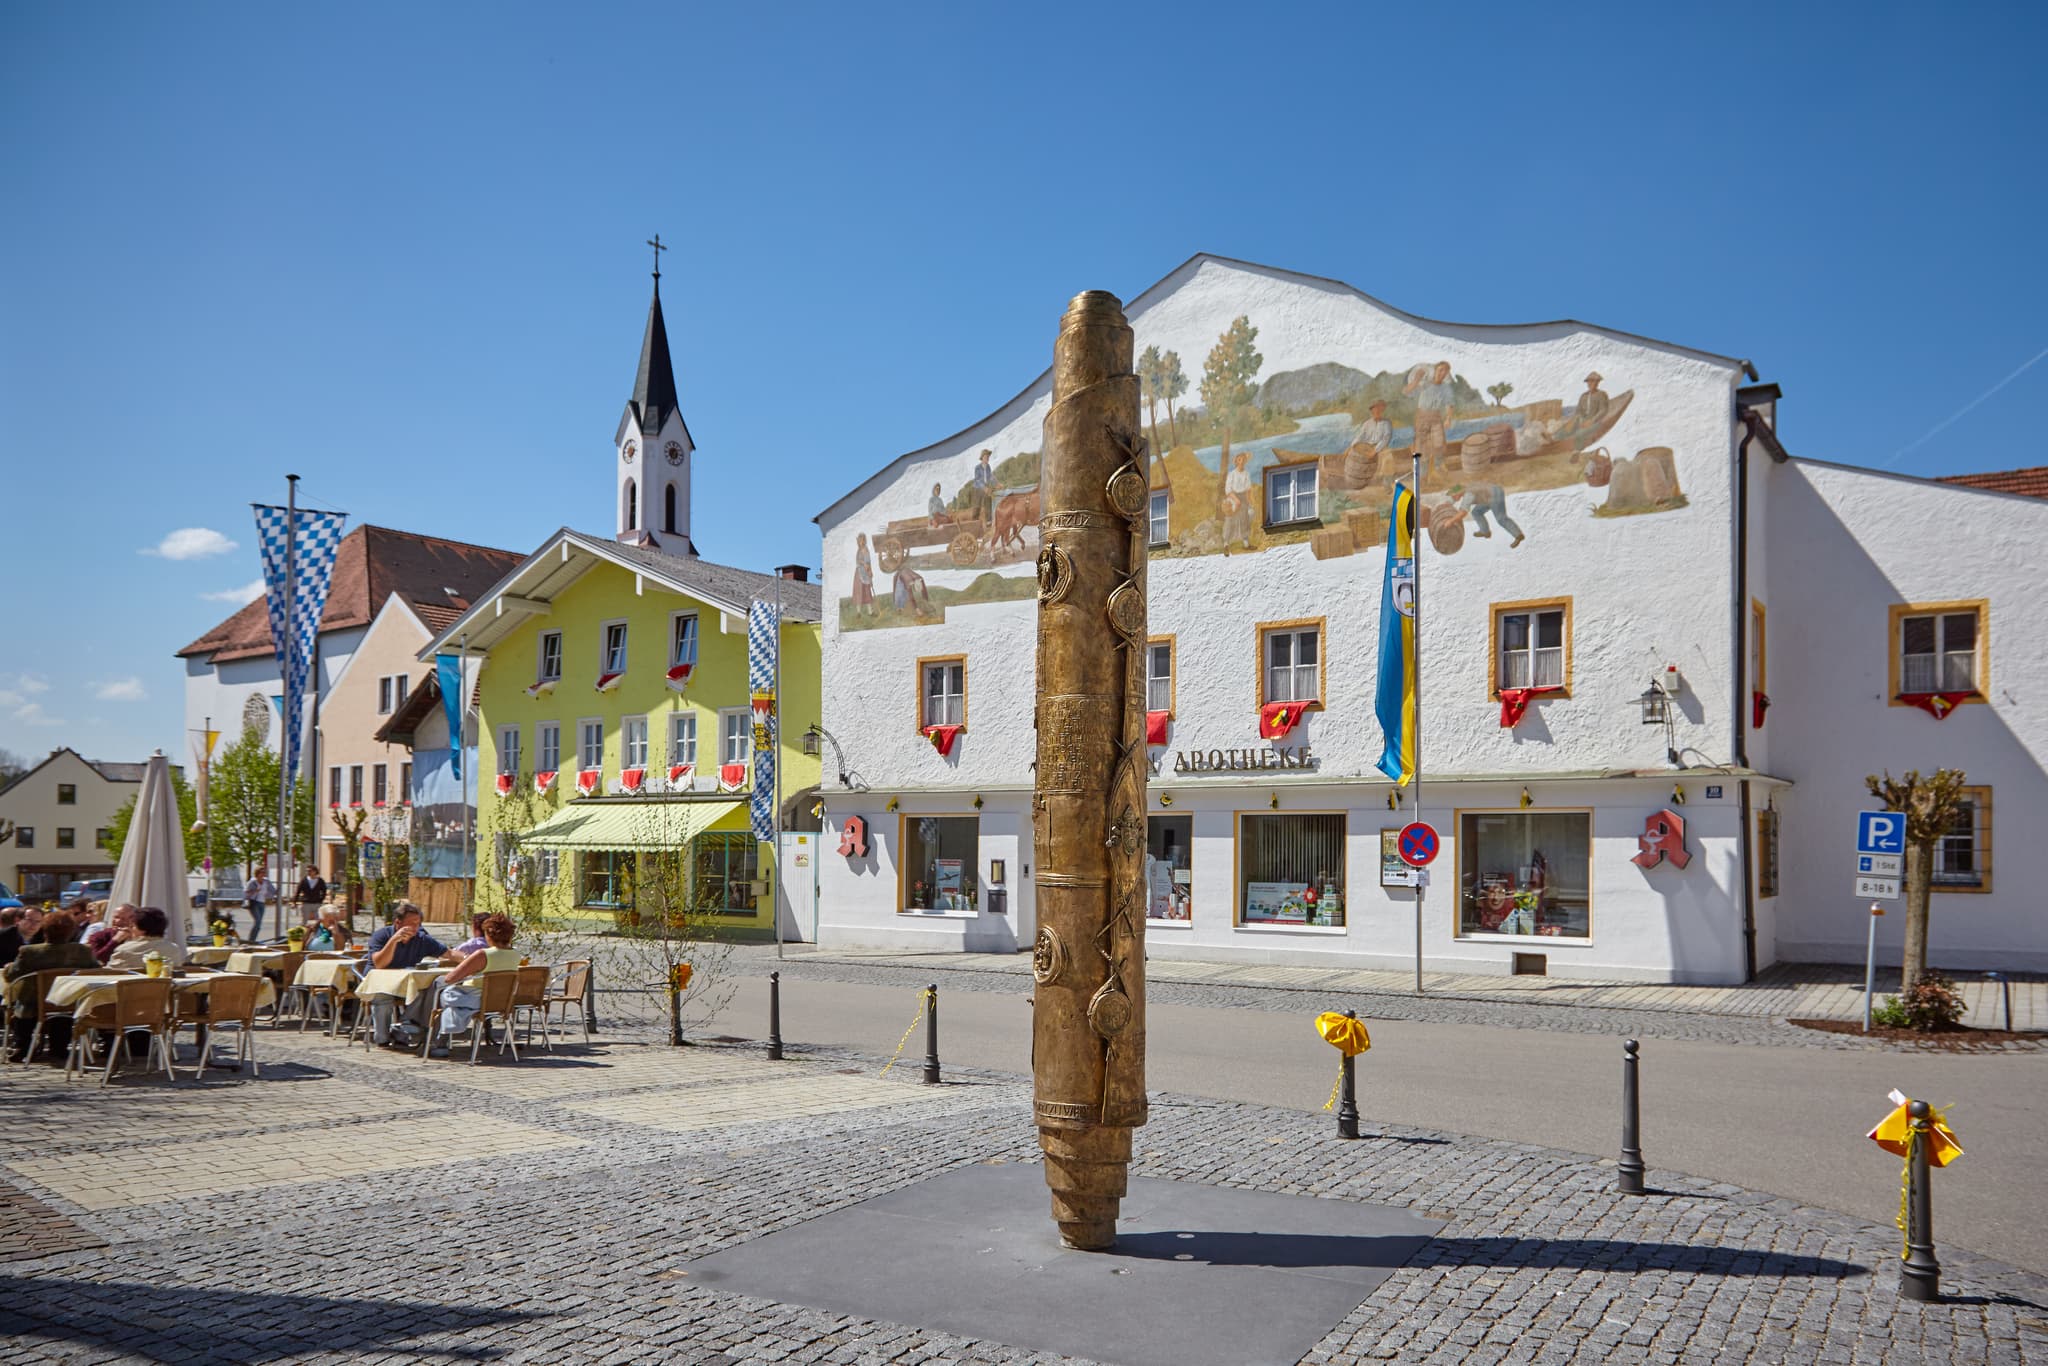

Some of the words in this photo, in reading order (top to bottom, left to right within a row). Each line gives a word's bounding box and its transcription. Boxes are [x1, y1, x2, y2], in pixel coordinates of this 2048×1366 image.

[1174, 746, 1313, 772] APOTHEKE
[836, 815, 870, 857] A
[1631, 809, 1692, 870] A
[1867, 817, 1894, 848] P
[1861, 882, 1885, 893] 8-18
[1887, 884, 1893, 894] h
